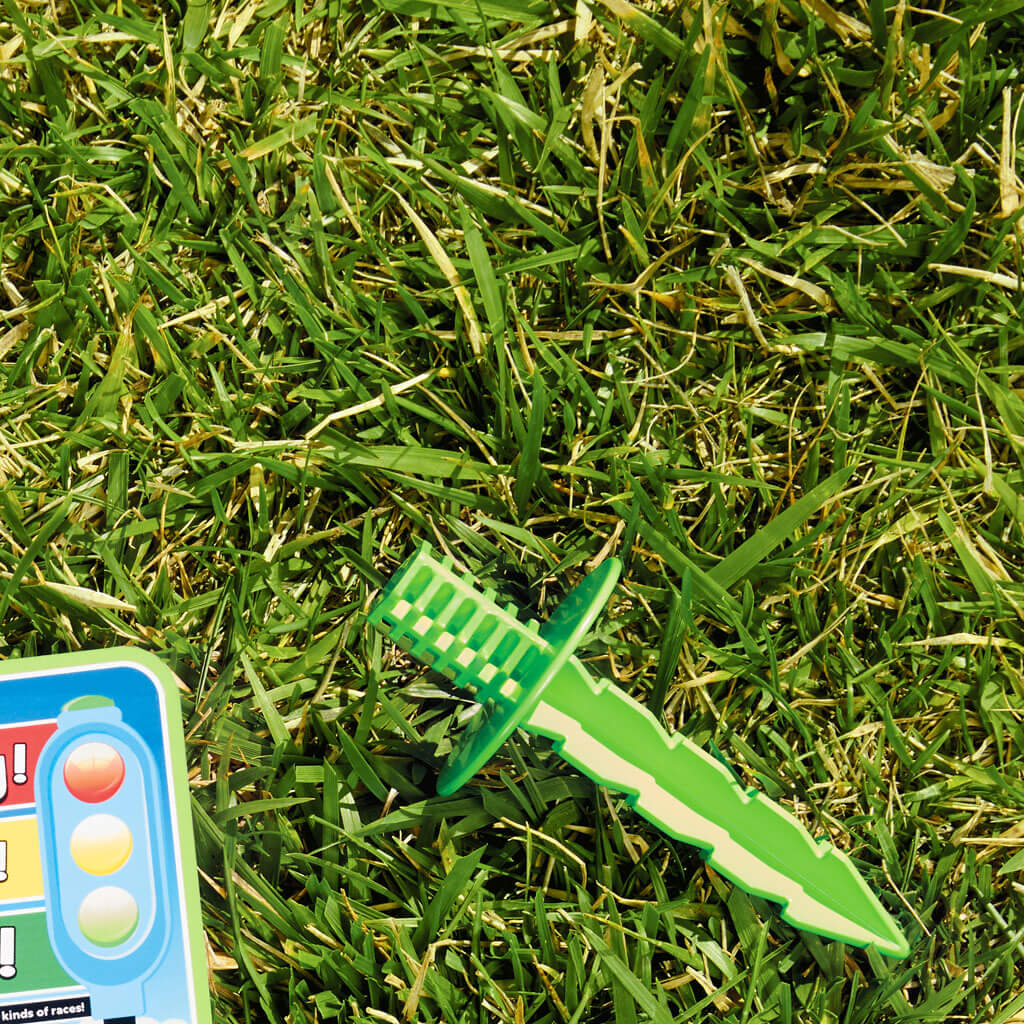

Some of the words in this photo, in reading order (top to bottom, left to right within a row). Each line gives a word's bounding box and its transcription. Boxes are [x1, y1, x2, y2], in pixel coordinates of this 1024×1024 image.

[0, 1007, 34, 1022] kinds
[35, 1005, 50, 1018] of
[49, 1001, 86, 1016] races!
